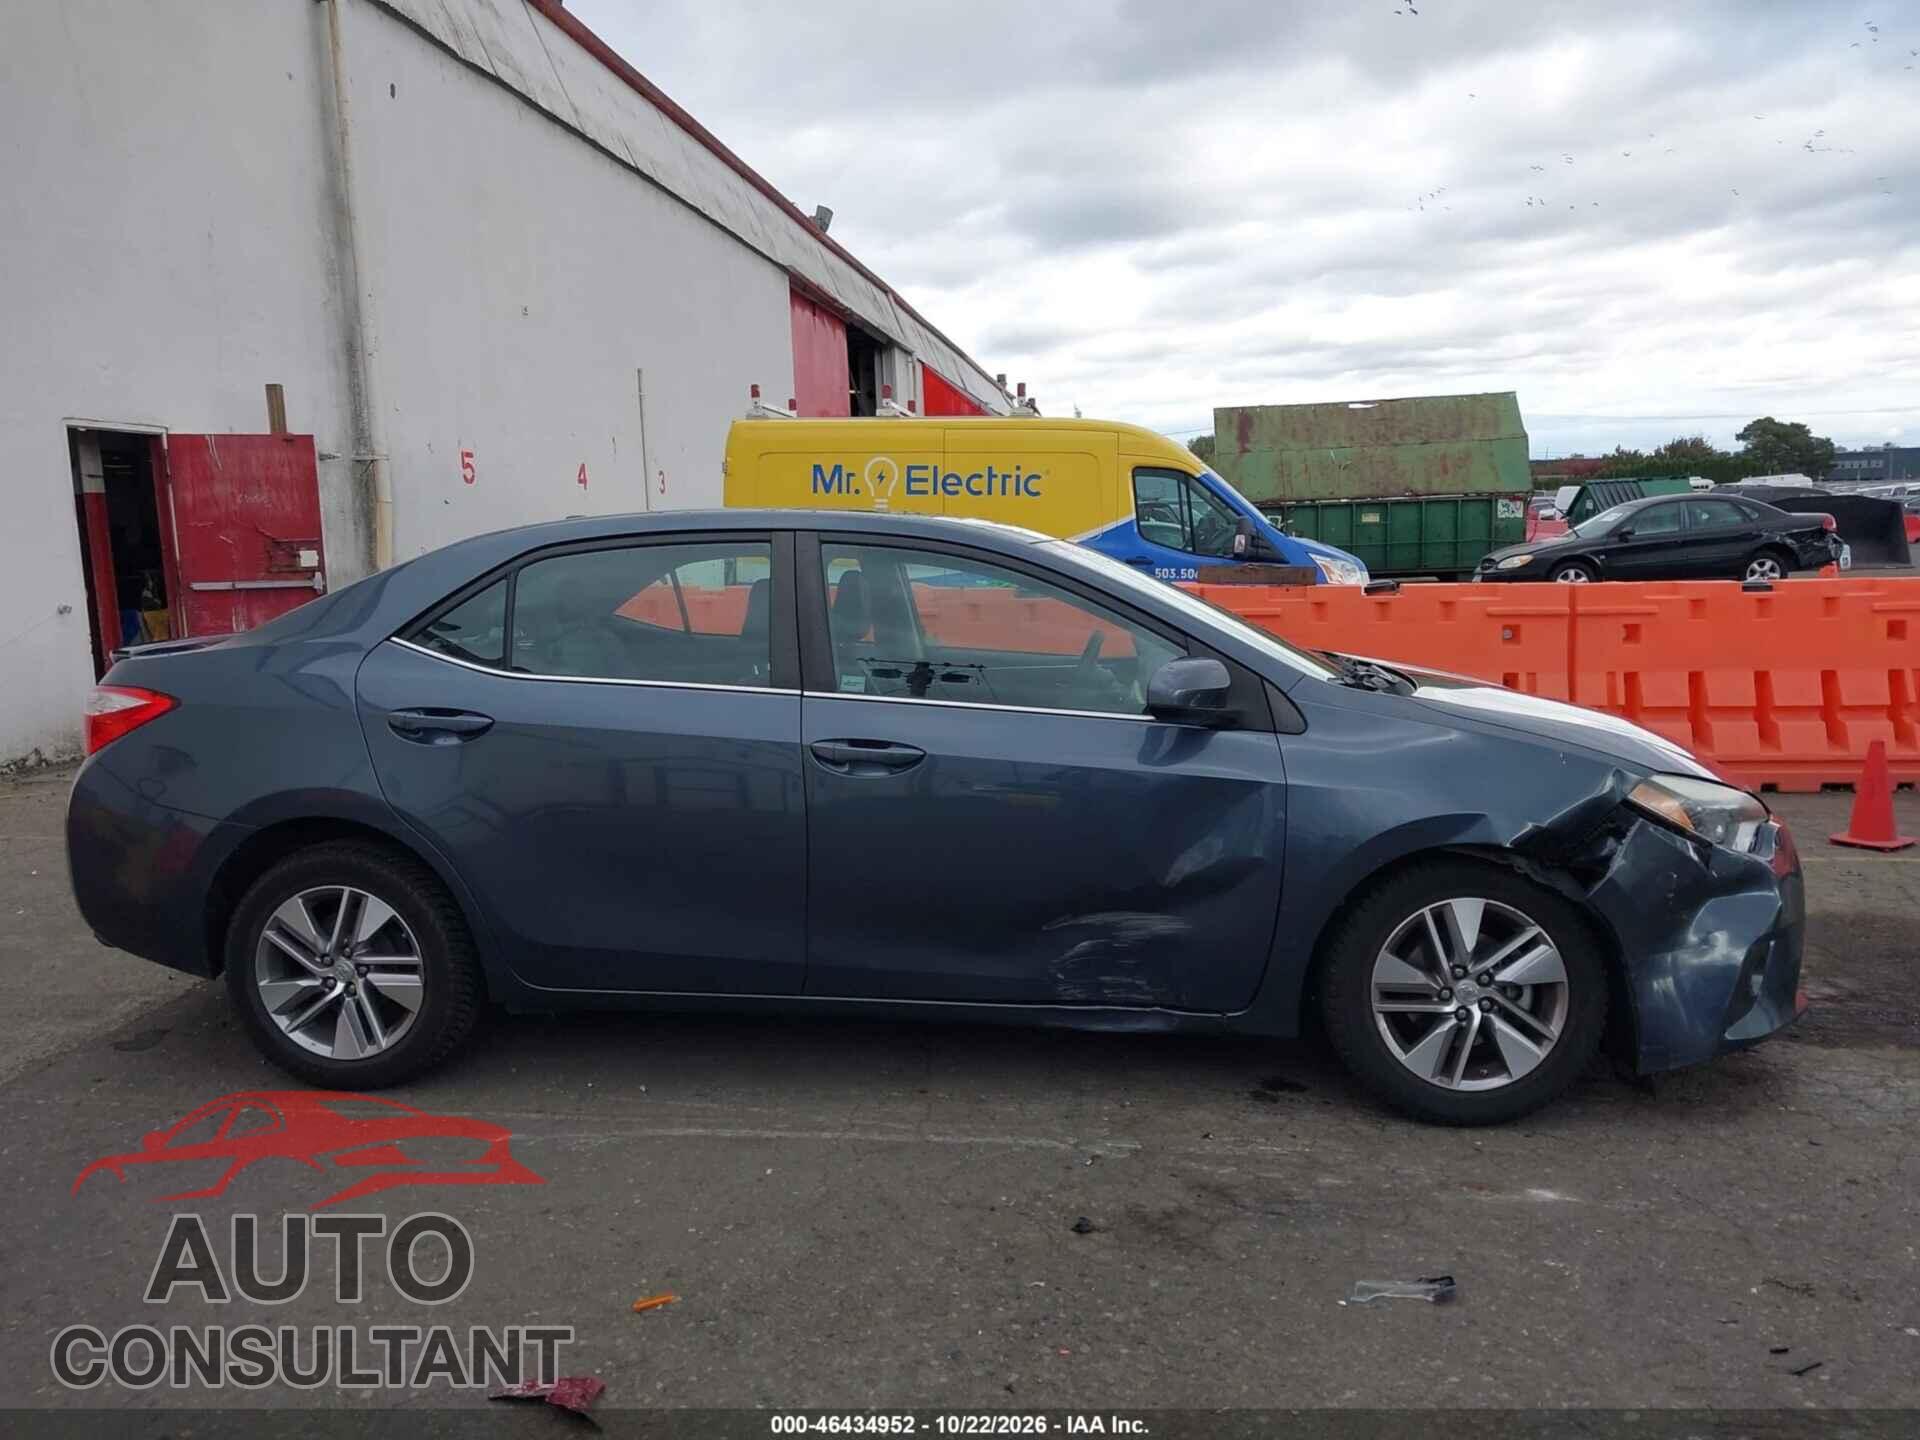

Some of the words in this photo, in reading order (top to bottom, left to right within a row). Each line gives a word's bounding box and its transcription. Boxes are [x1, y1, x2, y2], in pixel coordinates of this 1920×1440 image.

[461, 450, 476, 484] 5
[577, 463, 588, 490] 4
[659, 470, 666, 494] 3
[812, 464, 860, 495] Mr.
[906, 465, 1042, 497] Electric
